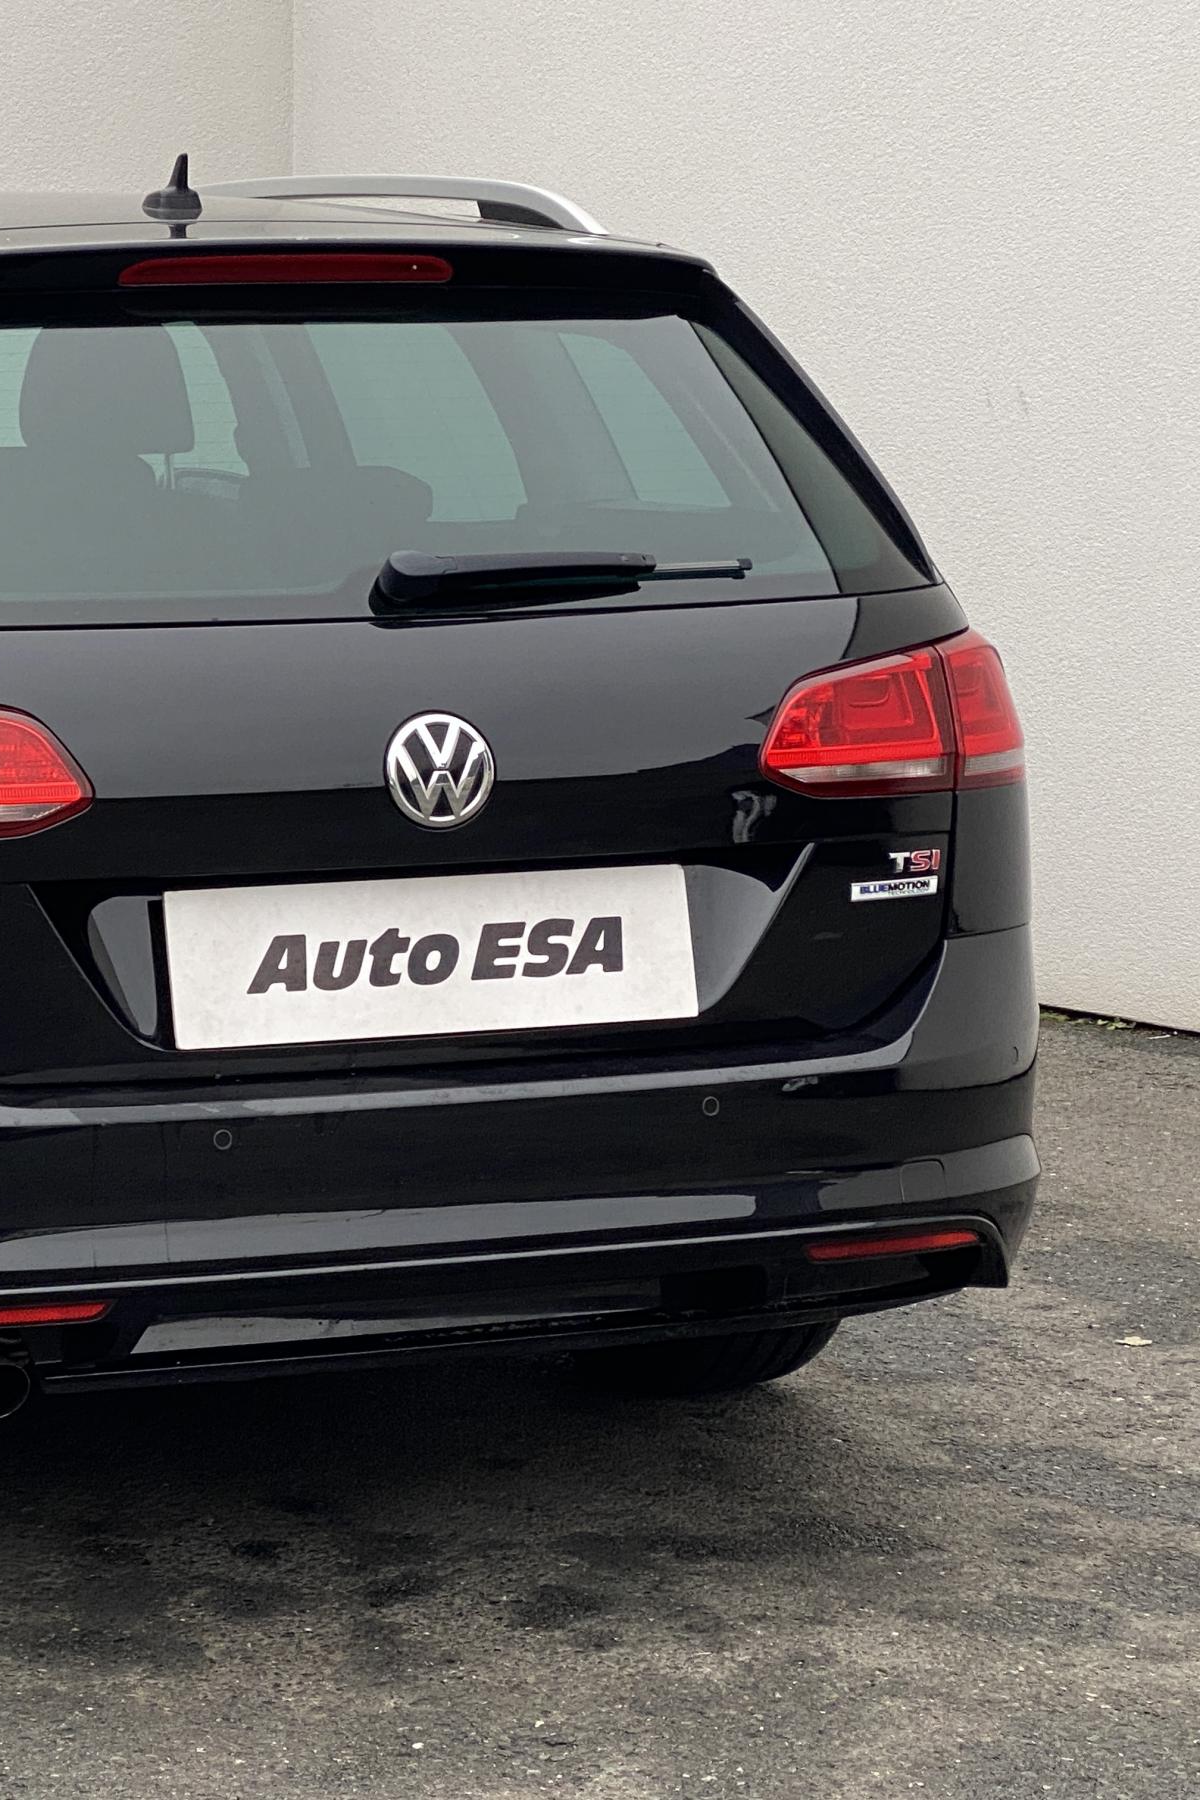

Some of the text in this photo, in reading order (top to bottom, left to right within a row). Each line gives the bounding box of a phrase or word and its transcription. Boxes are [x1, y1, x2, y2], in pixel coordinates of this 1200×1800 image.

[386, 713, 495, 828] VW
[889, 849, 941, 873] TSI
[860, 880, 930, 895] BLUEMOTION
[246, 916, 624, 995] Auto ESA
